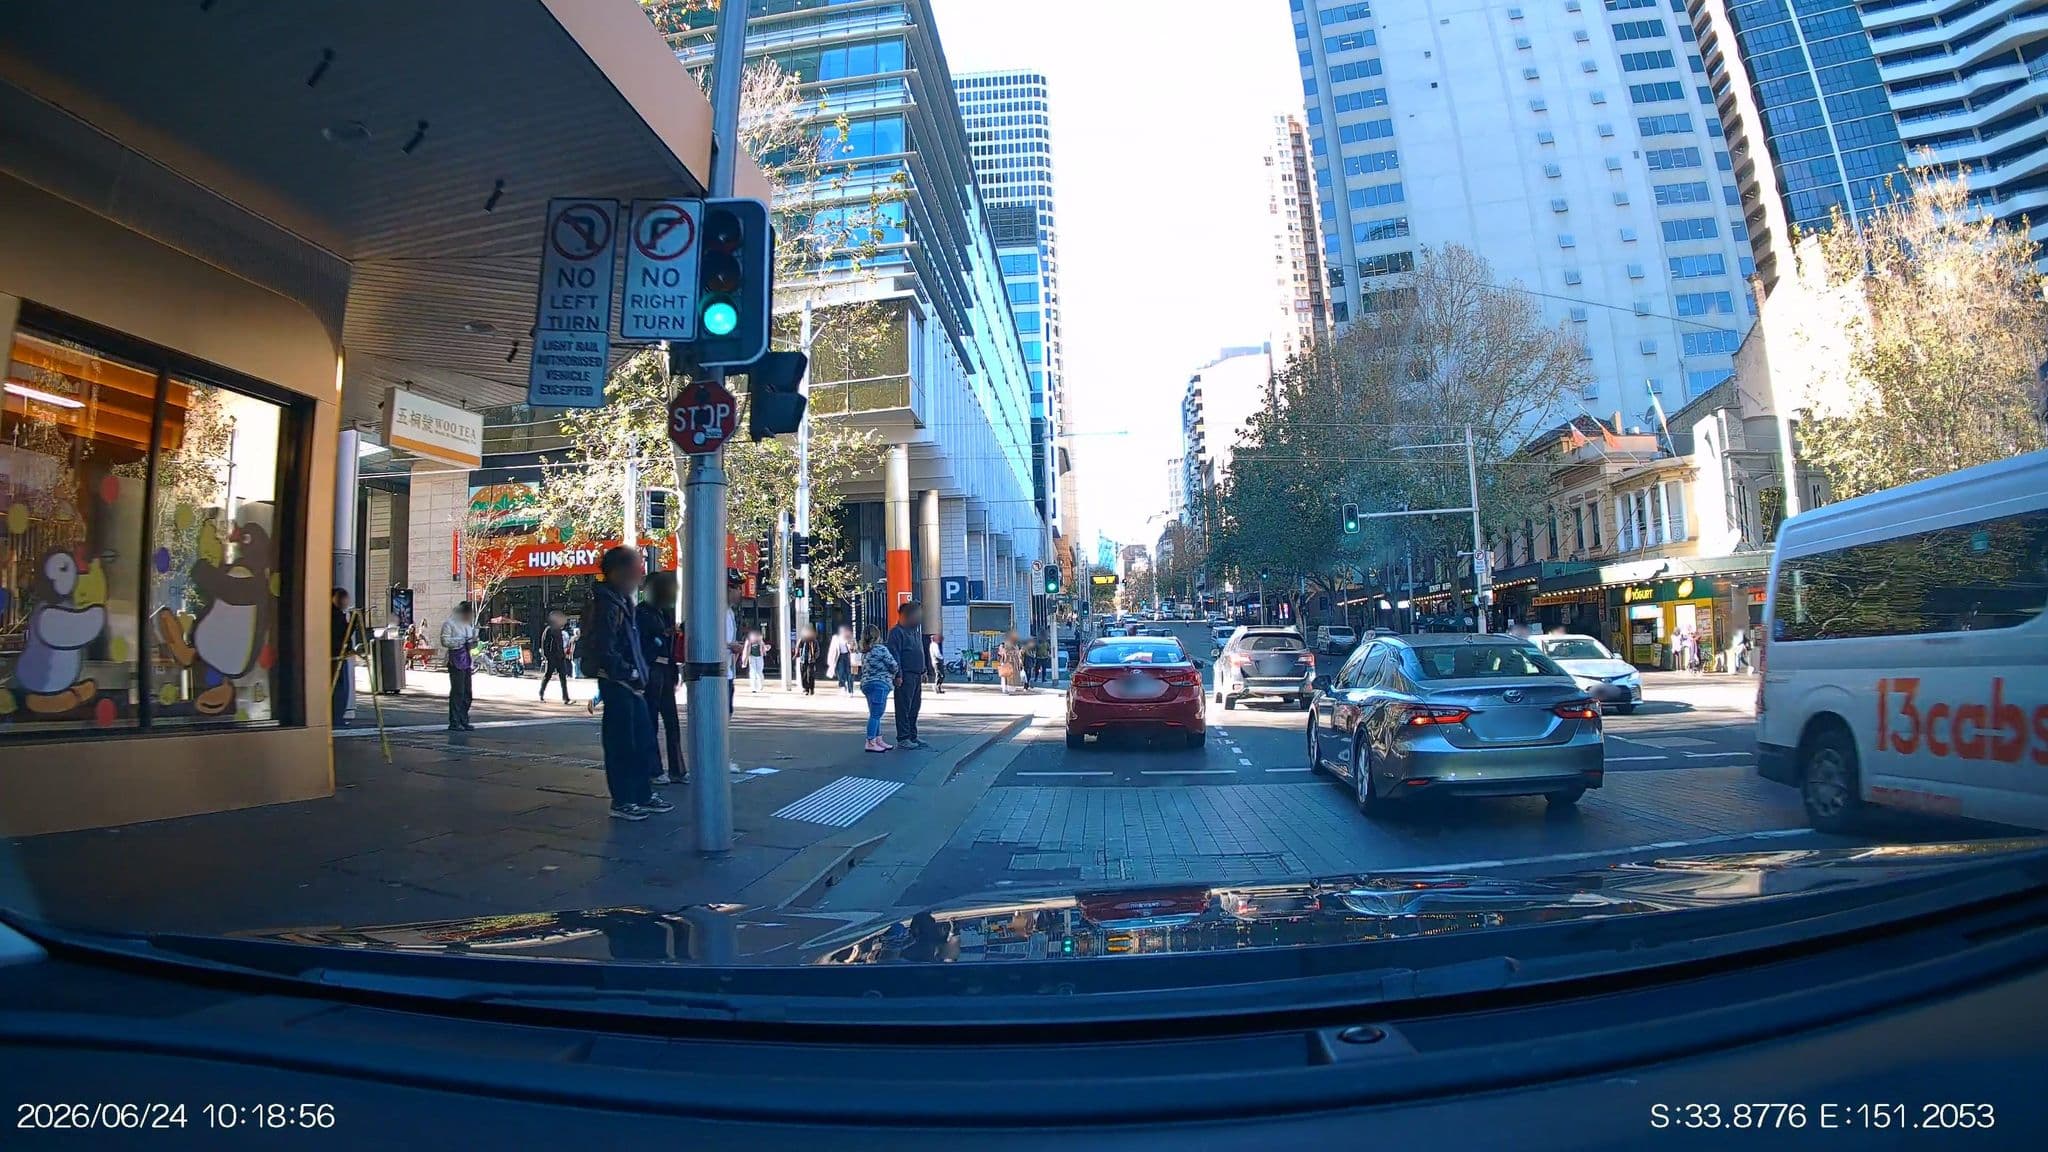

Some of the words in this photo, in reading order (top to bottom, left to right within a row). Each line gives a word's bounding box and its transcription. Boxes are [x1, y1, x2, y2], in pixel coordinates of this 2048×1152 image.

[558, 268, 596, 288] NO
[642, 267, 680, 288] NO
[550, 295, 599, 310] LEFT
[630, 294, 688, 309] RIGHT
[547, 316, 600, 330] TURN
[632, 315, 685, 330] TURN
[543, 340, 573, 351] LIGHT
[576, 341, 600, 352] RAIL
[538, 355, 602, 367] AUTHORISED
[545, 370, 592, 382] VEHICLE
[540, 384, 593, 396] EXCEPTED
[434, 418, 457, 434] WOO
[458, 425, 476, 440] TEA
[528, 549, 597, 568] HUNGRY
[945, 581, 960, 599] P
[1877, 677, 2048, 766] 13cabs
